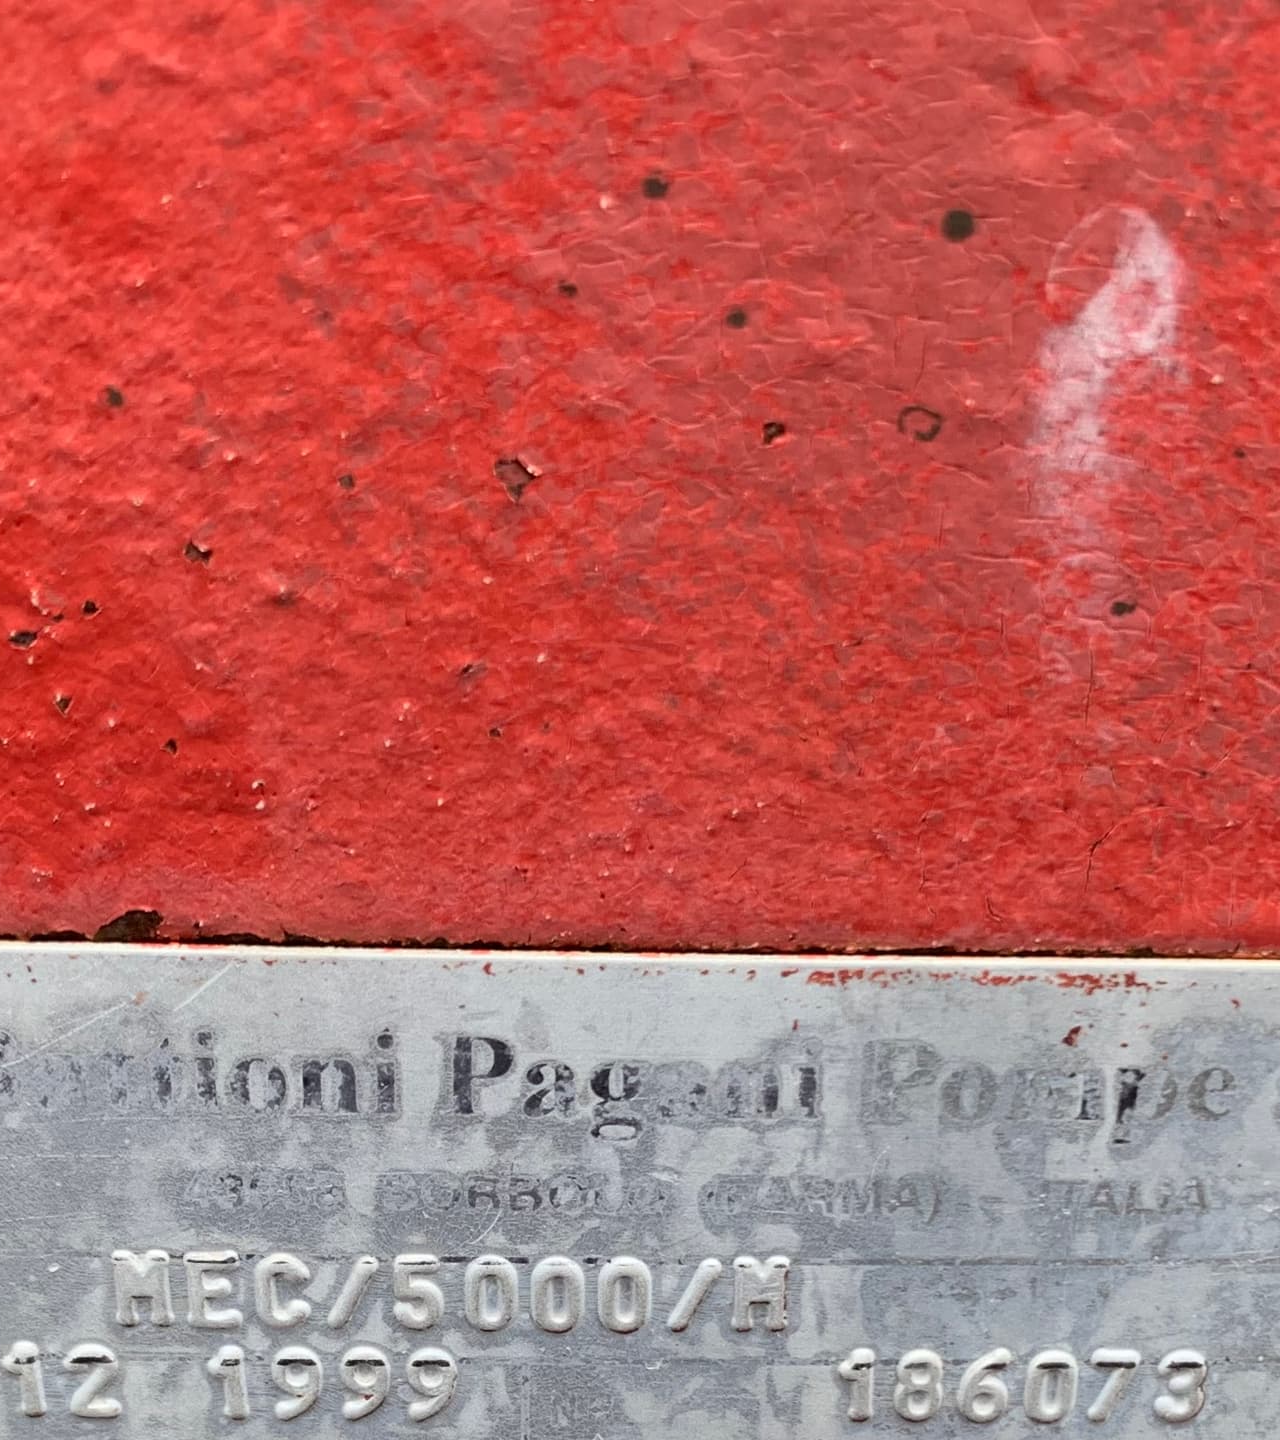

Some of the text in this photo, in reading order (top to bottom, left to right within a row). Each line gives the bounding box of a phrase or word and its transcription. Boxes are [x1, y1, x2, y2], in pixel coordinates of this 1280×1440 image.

[111, 1249, 792, 1334] MEC/5000/M
[2, 1341, 122, 1419] 12
[208, 1344, 458, 1422] 1999
[837, 1346, 1208, 1424] 186073
